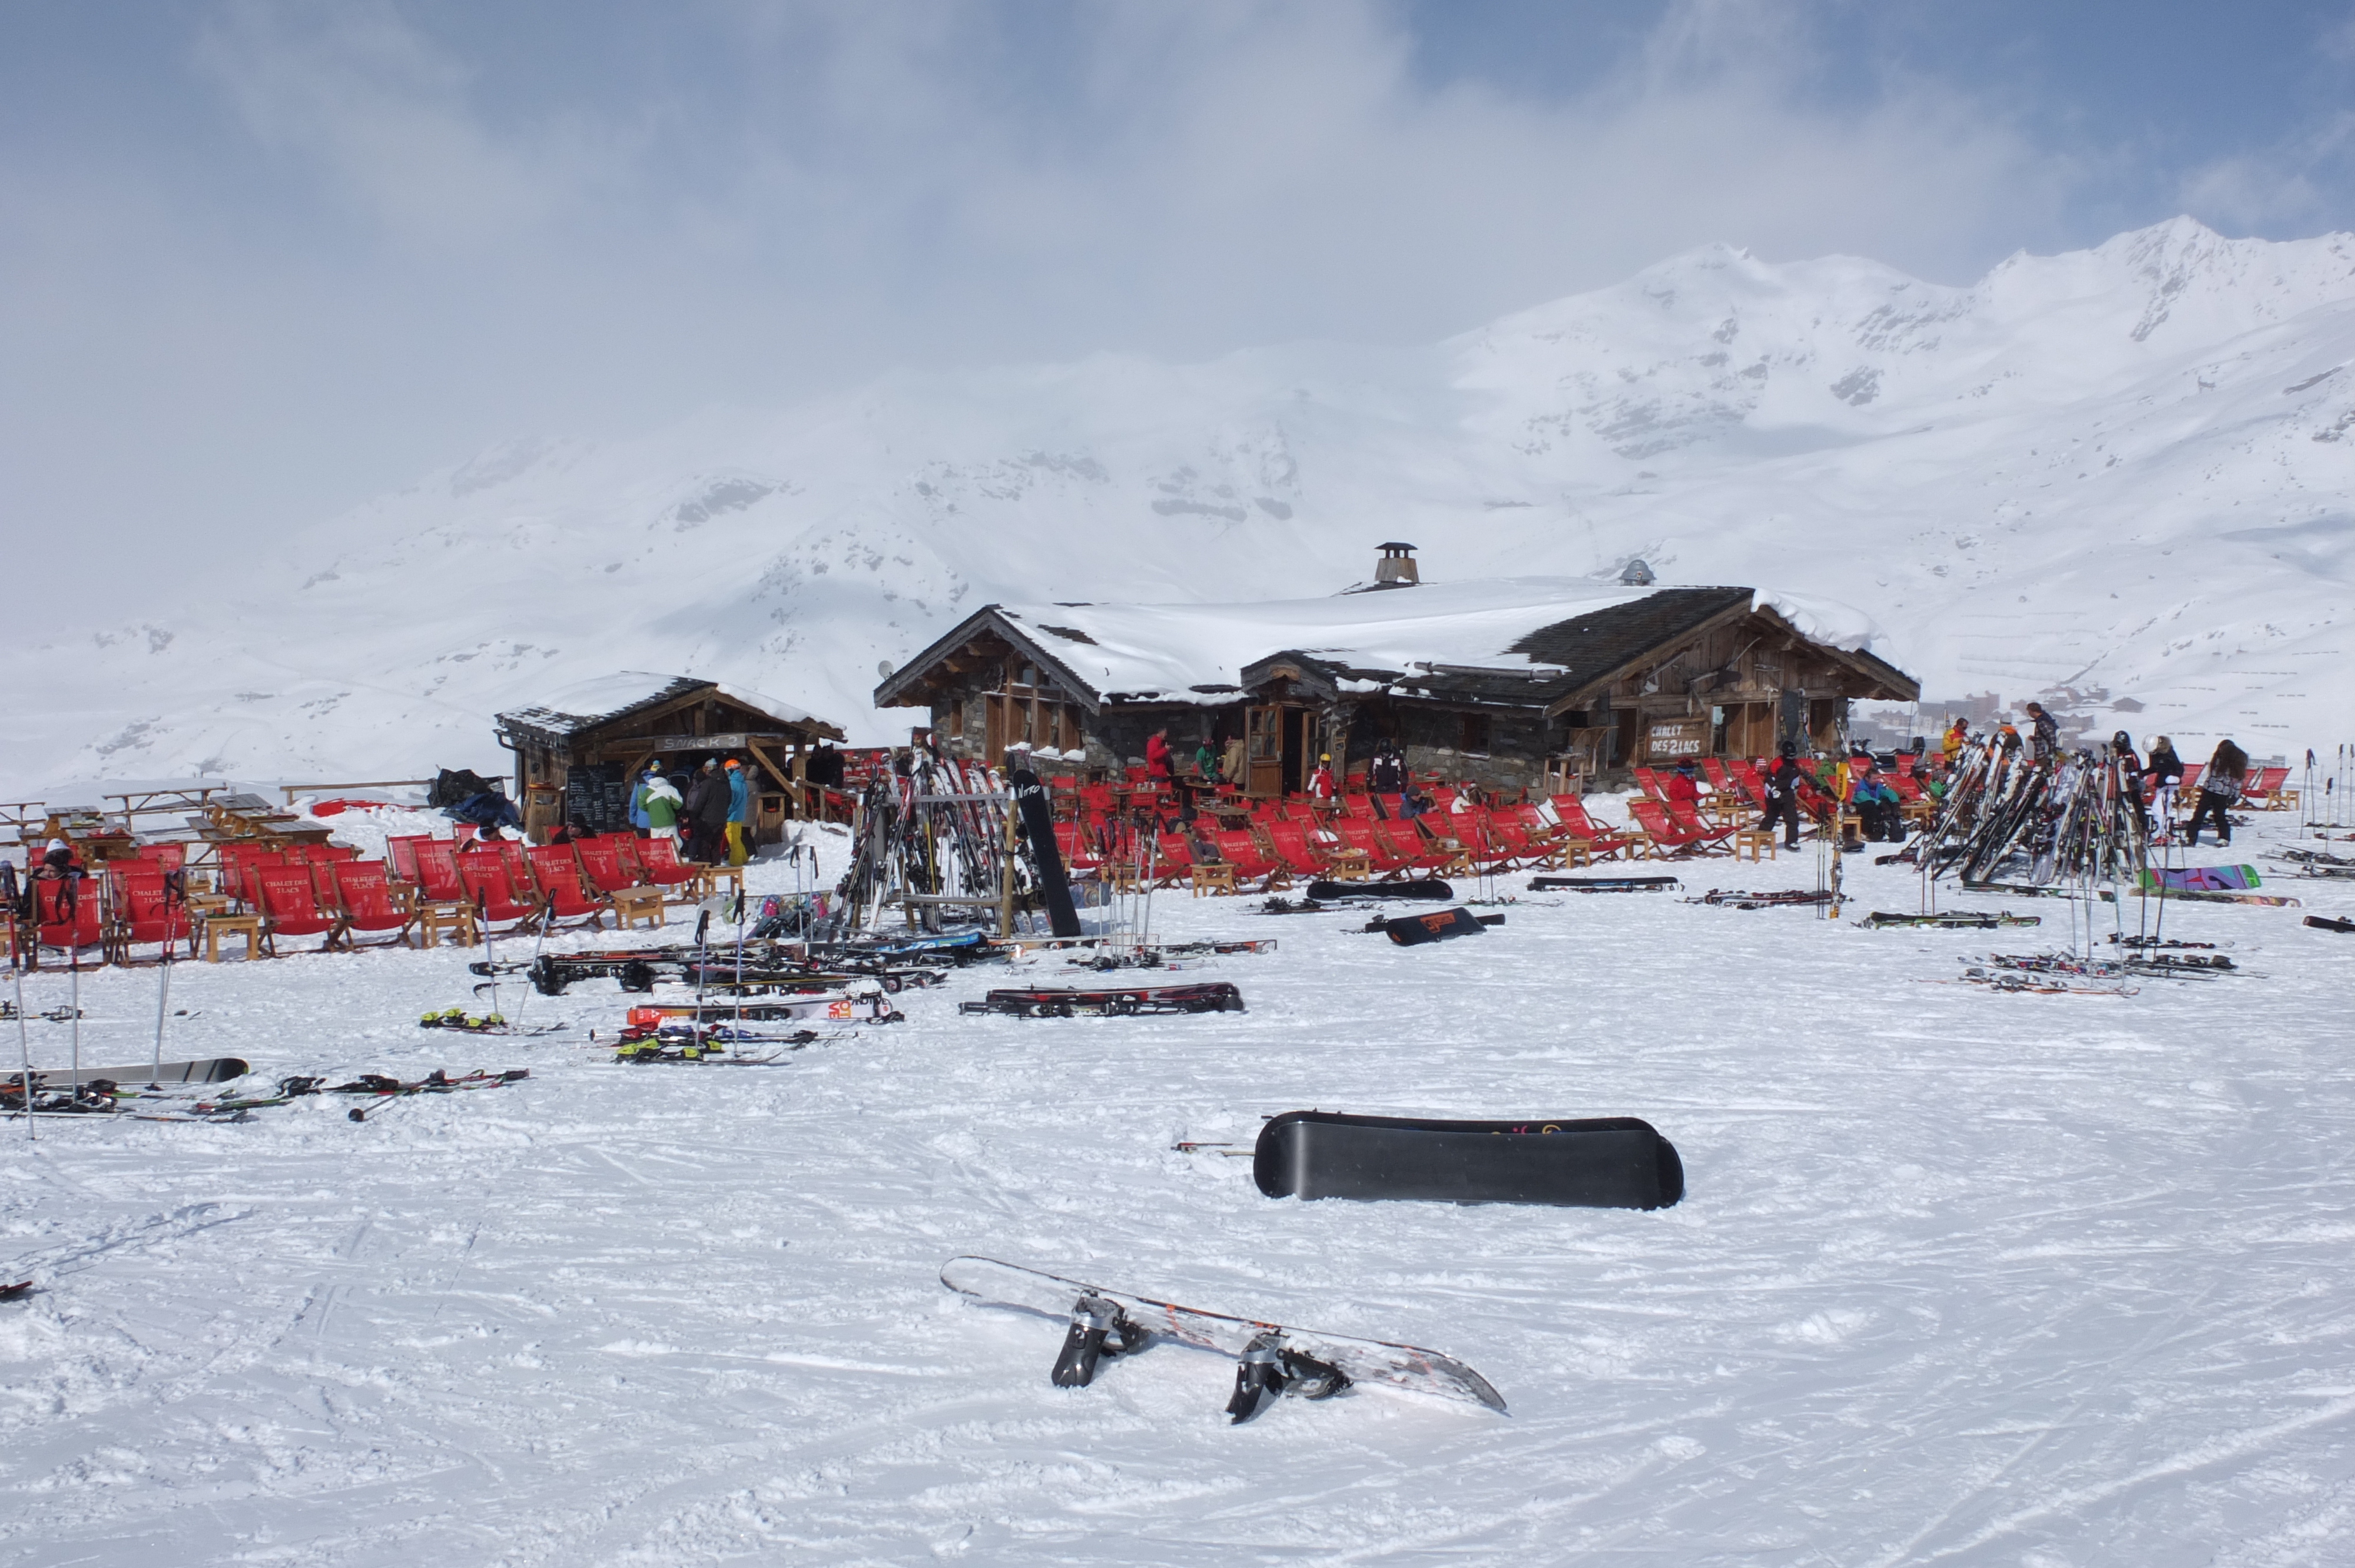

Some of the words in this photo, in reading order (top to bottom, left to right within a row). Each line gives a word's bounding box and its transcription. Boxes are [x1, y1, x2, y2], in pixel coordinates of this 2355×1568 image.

[1651, 725, 1683, 737] CHALET
[664, 738, 719, 749] SNACK
[1651, 739, 1668, 752] DES
[1679, 739, 1700, 753] LACS
